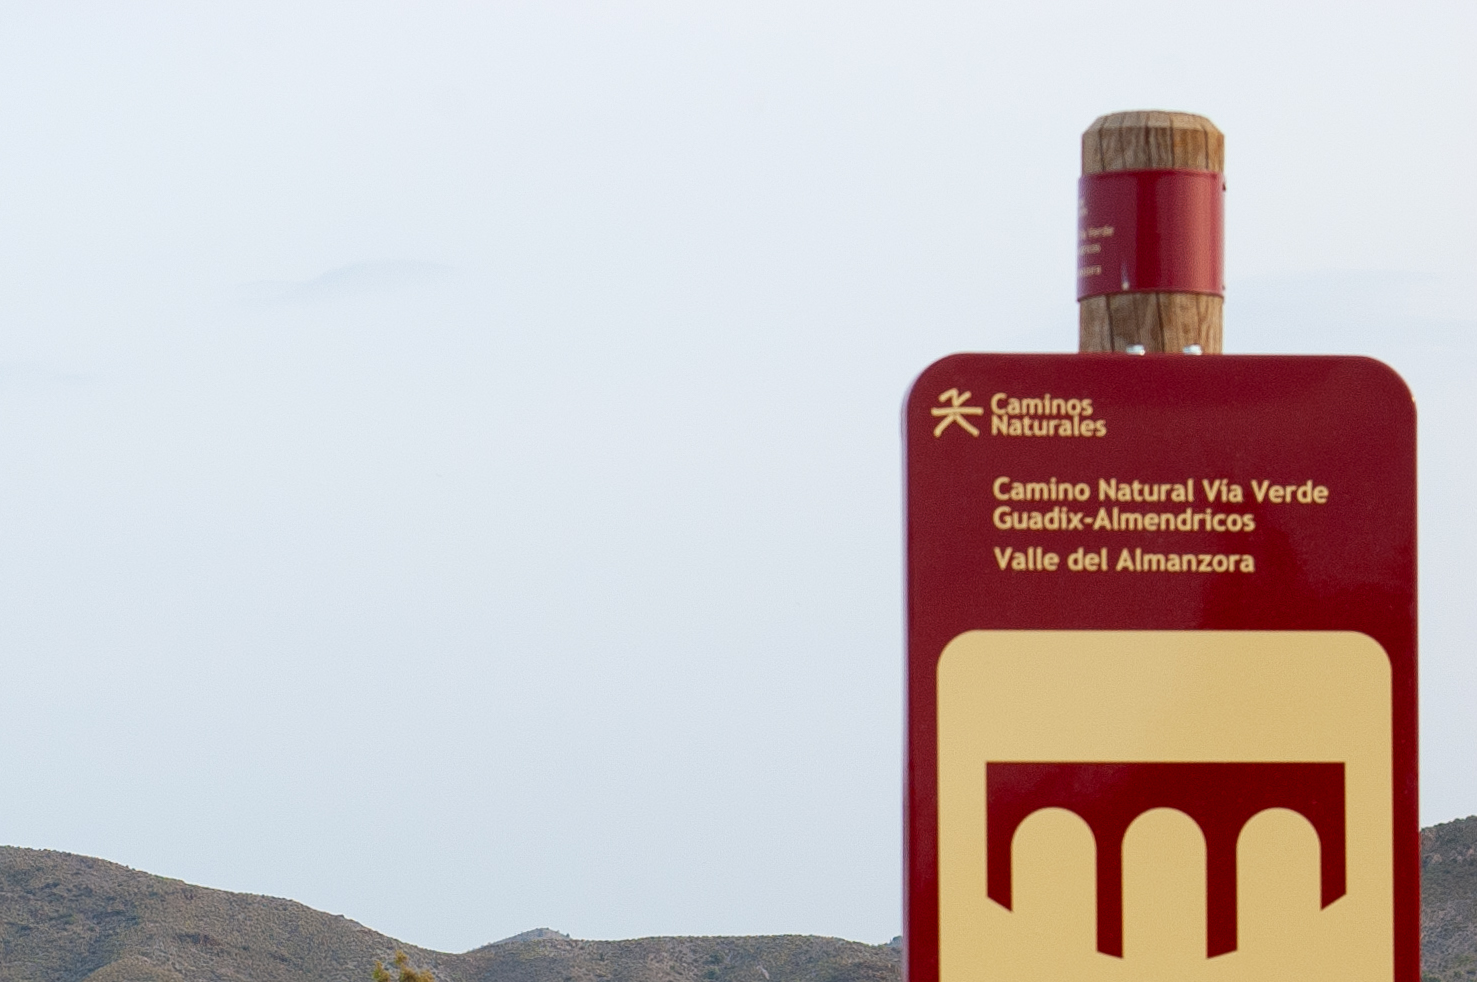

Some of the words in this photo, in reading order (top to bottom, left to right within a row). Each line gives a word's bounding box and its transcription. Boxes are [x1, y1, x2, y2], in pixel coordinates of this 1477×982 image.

[991, 392, 1093, 415] Caminos
[991, 414, 1107, 437] Naturales
[993, 477, 1090, 501] Camino
[1099, 478, 1194, 502] Natural
[1251, 480, 1328, 503] Verde
[993, 506, 1255, 531] Guadix-Almendricos
[994, 547, 1059, 571] Valle
[1068, 548, 1107, 571] del
[1116, 548, 1254, 572] Almanzora
